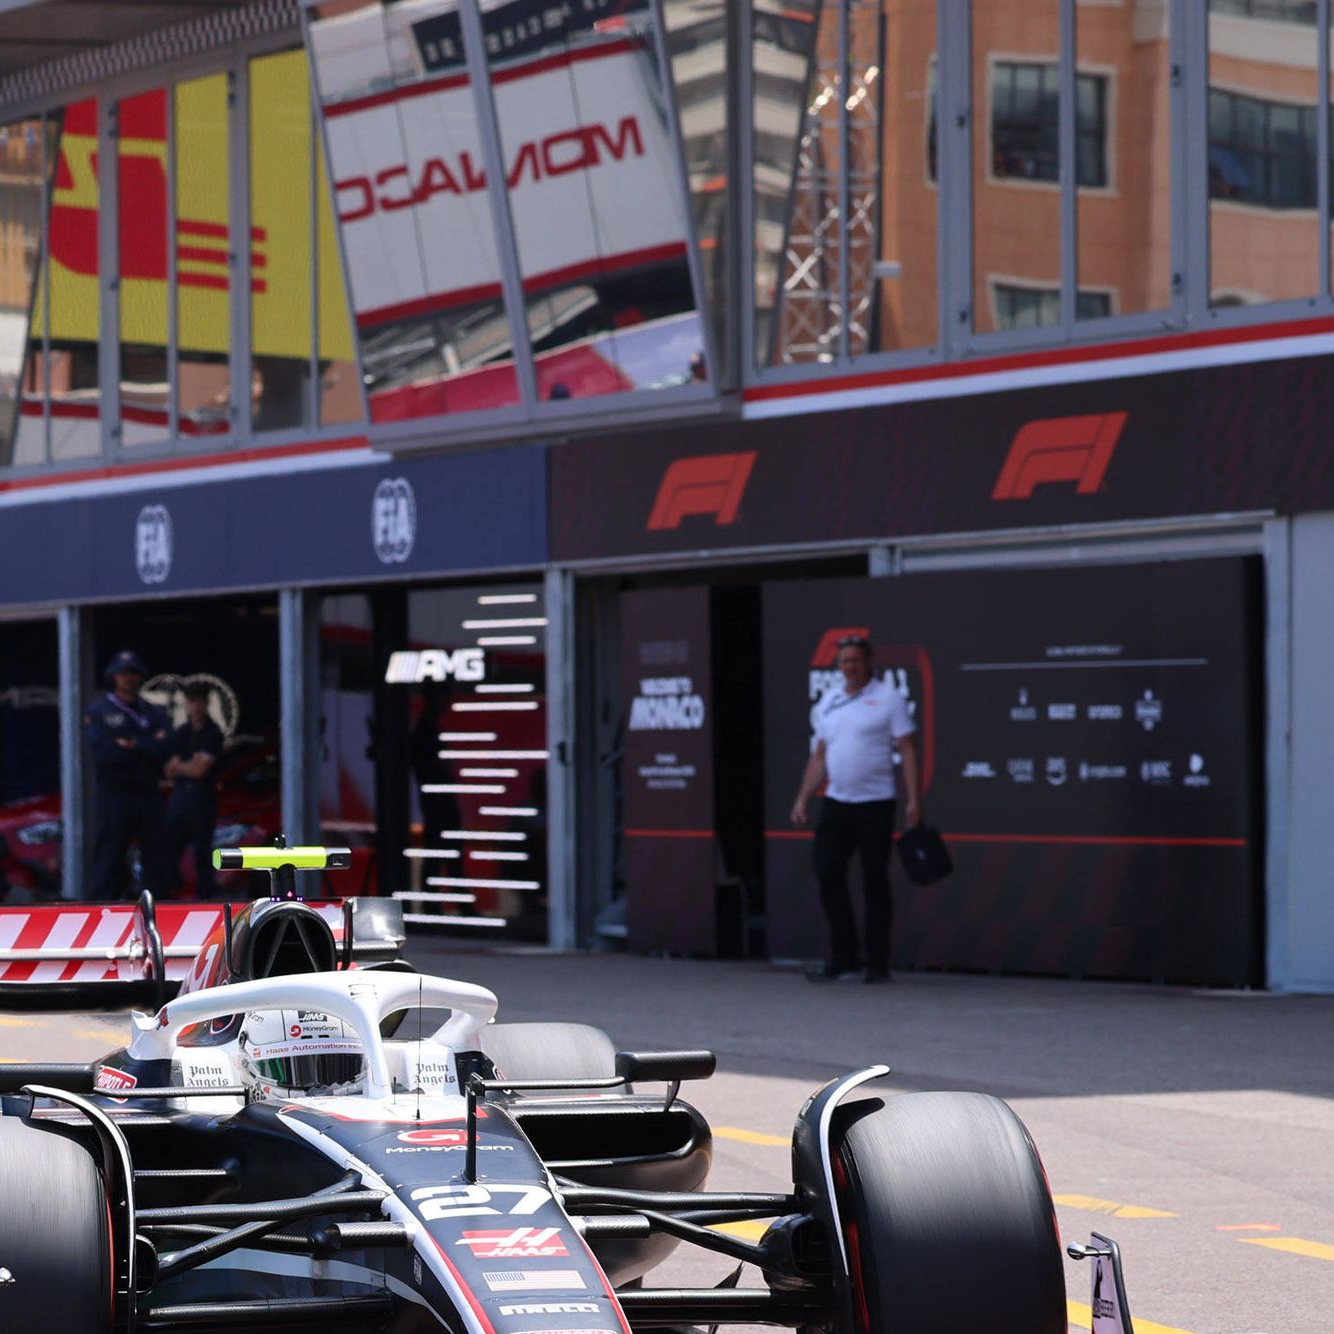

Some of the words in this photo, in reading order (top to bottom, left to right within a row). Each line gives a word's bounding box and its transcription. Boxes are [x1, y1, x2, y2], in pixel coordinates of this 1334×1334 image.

[418, 648, 485, 682] AMG
[302, 1024, 339, 1033] MoneyGram
[291, 1042, 348, 1053] Automation
[188, 1065, 223, 1077] Palm
[415, 1063, 450, 1074] Palm
[186, 1076, 230, 1088] Angels
[412, 1073, 457, 1087] Angels
[386, 1144, 515, 1155] MoneyGram
[410, 1182, 554, 1222] 27
[498, 1303, 601, 1317] PIRELLI
